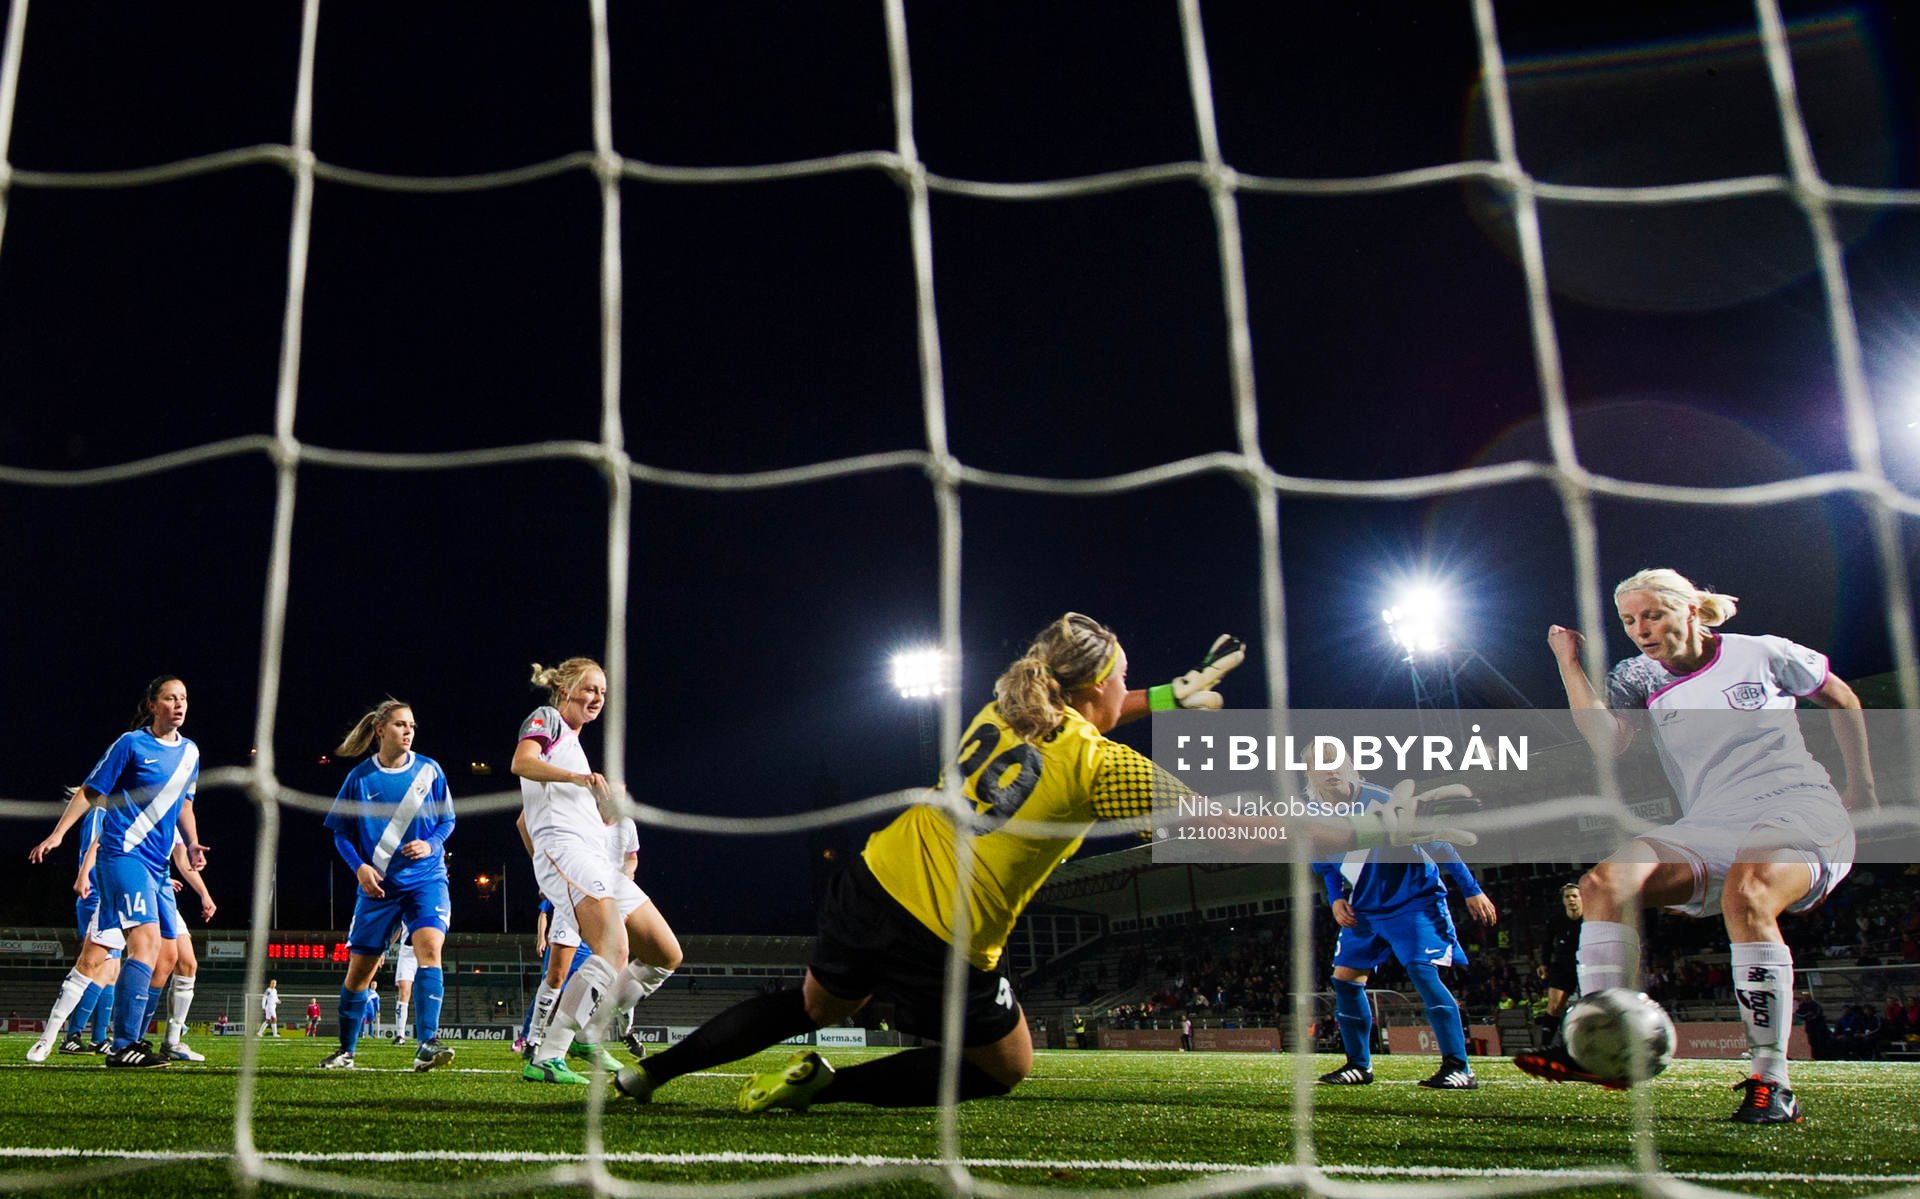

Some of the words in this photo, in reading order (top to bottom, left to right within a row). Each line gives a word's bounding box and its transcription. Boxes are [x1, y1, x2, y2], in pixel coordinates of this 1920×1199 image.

[593, 880, 606, 892] 3
[123, 891, 148, 917] 14
[466, 1028, 507, 1041] Kakel
[820, 1033, 863, 1043] kerma.se
